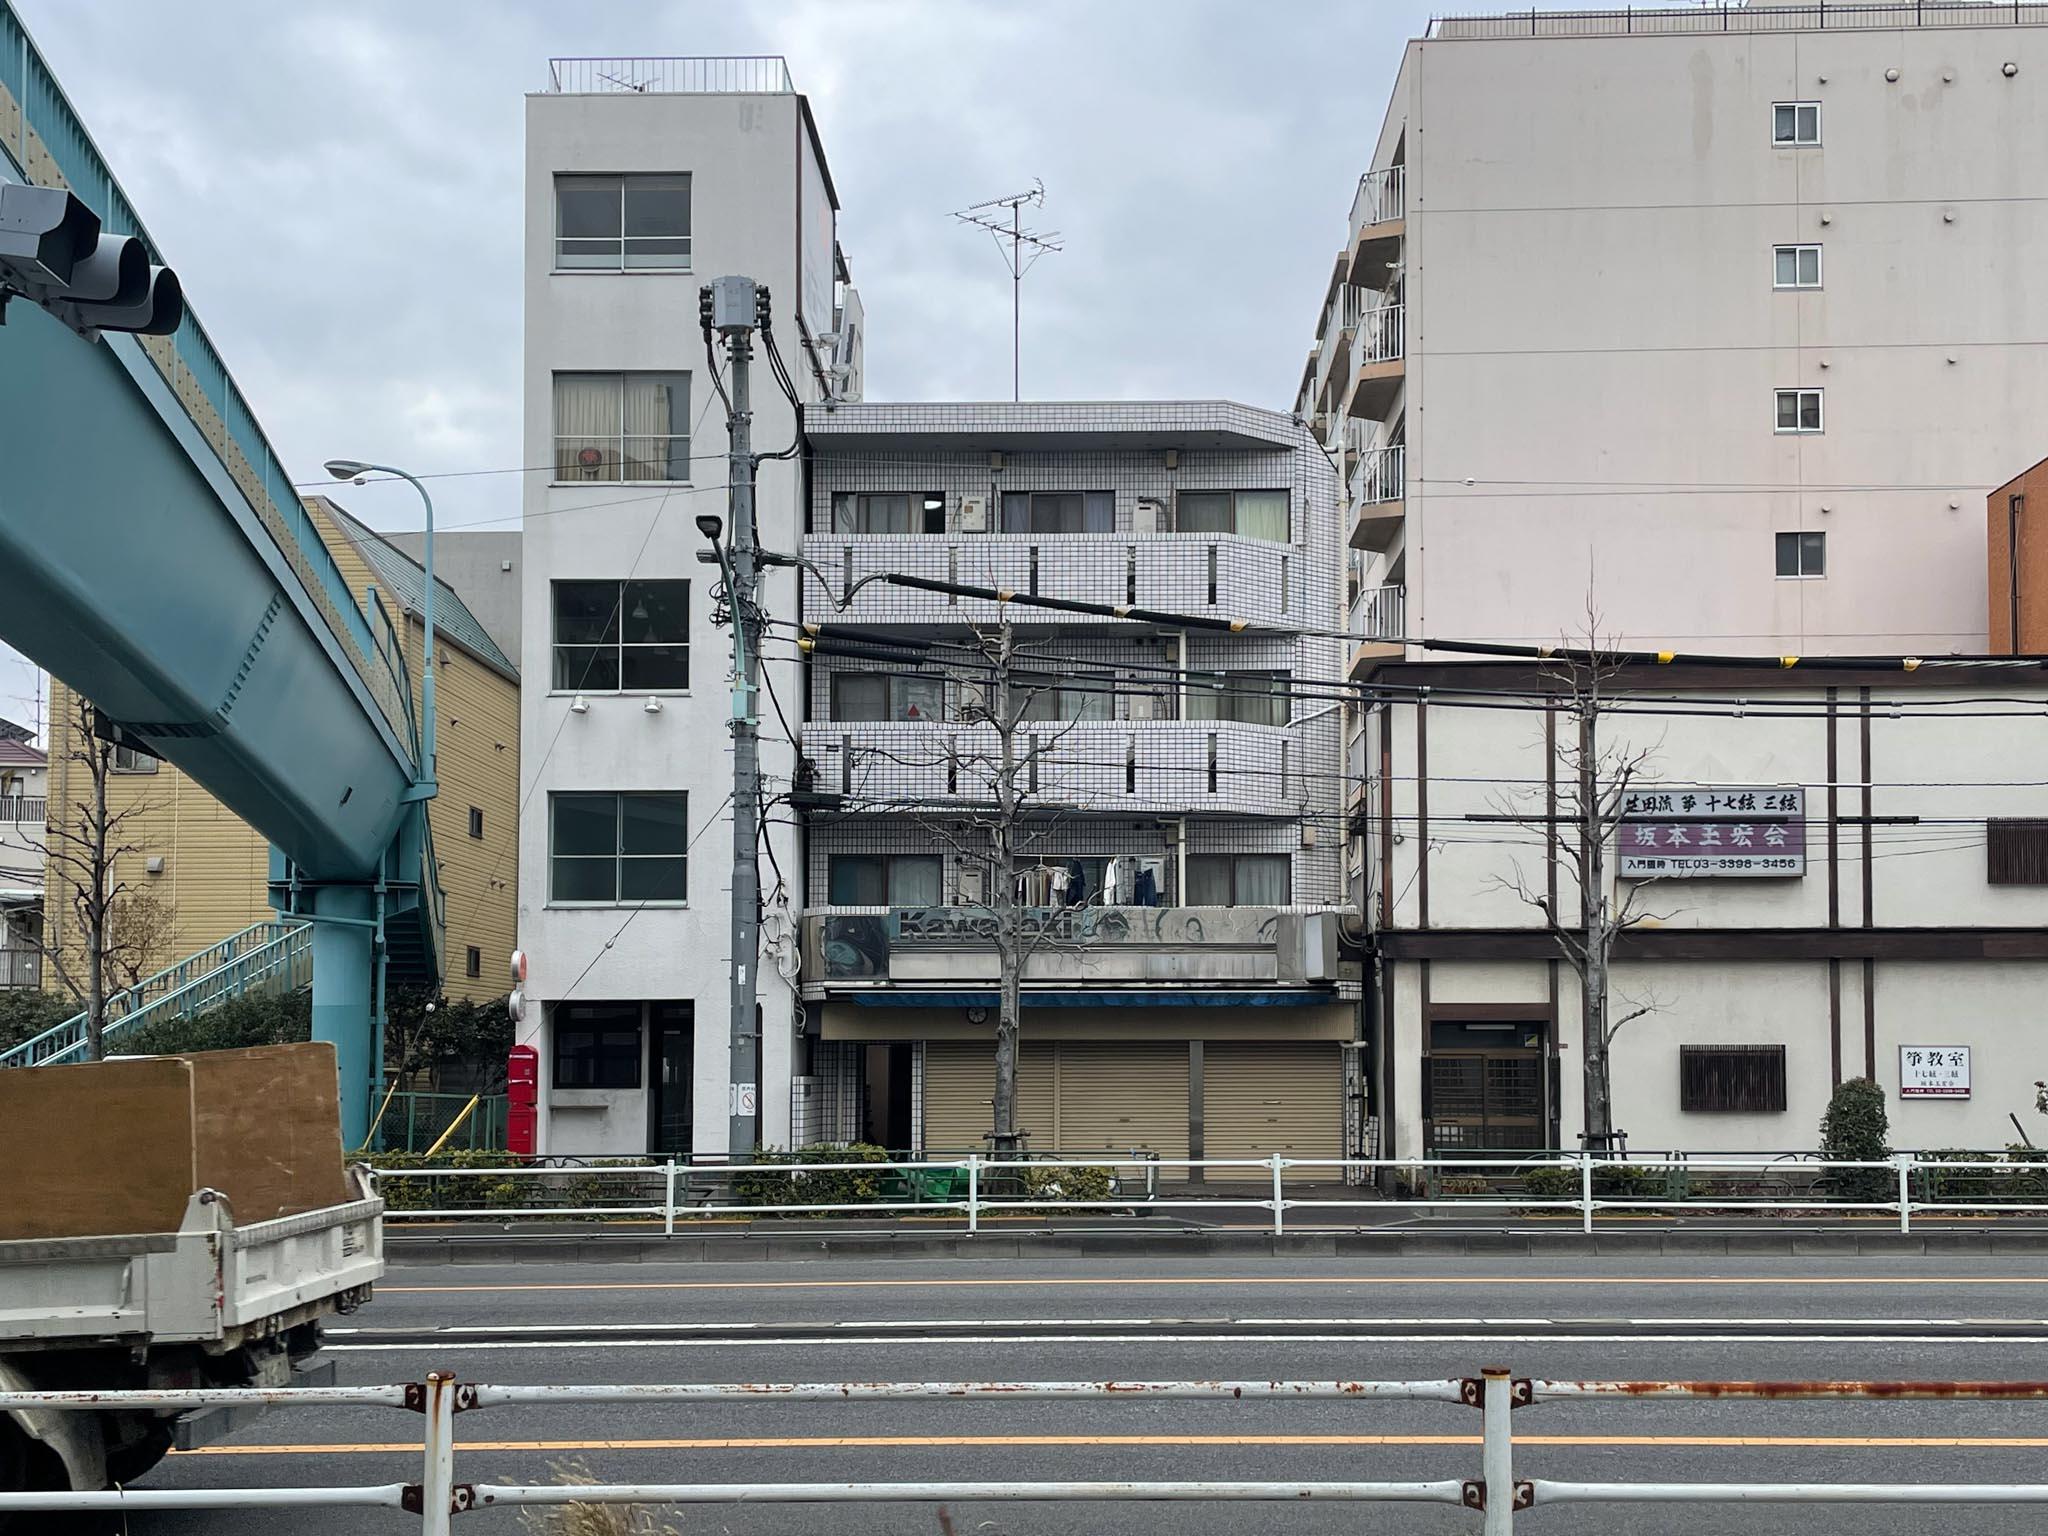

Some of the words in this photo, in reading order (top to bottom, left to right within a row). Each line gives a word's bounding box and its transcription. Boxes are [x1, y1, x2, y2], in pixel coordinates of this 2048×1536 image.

[1625, 793, 1674, 814] 生田流
[899, 911, 1072, 939] Kawaaki
